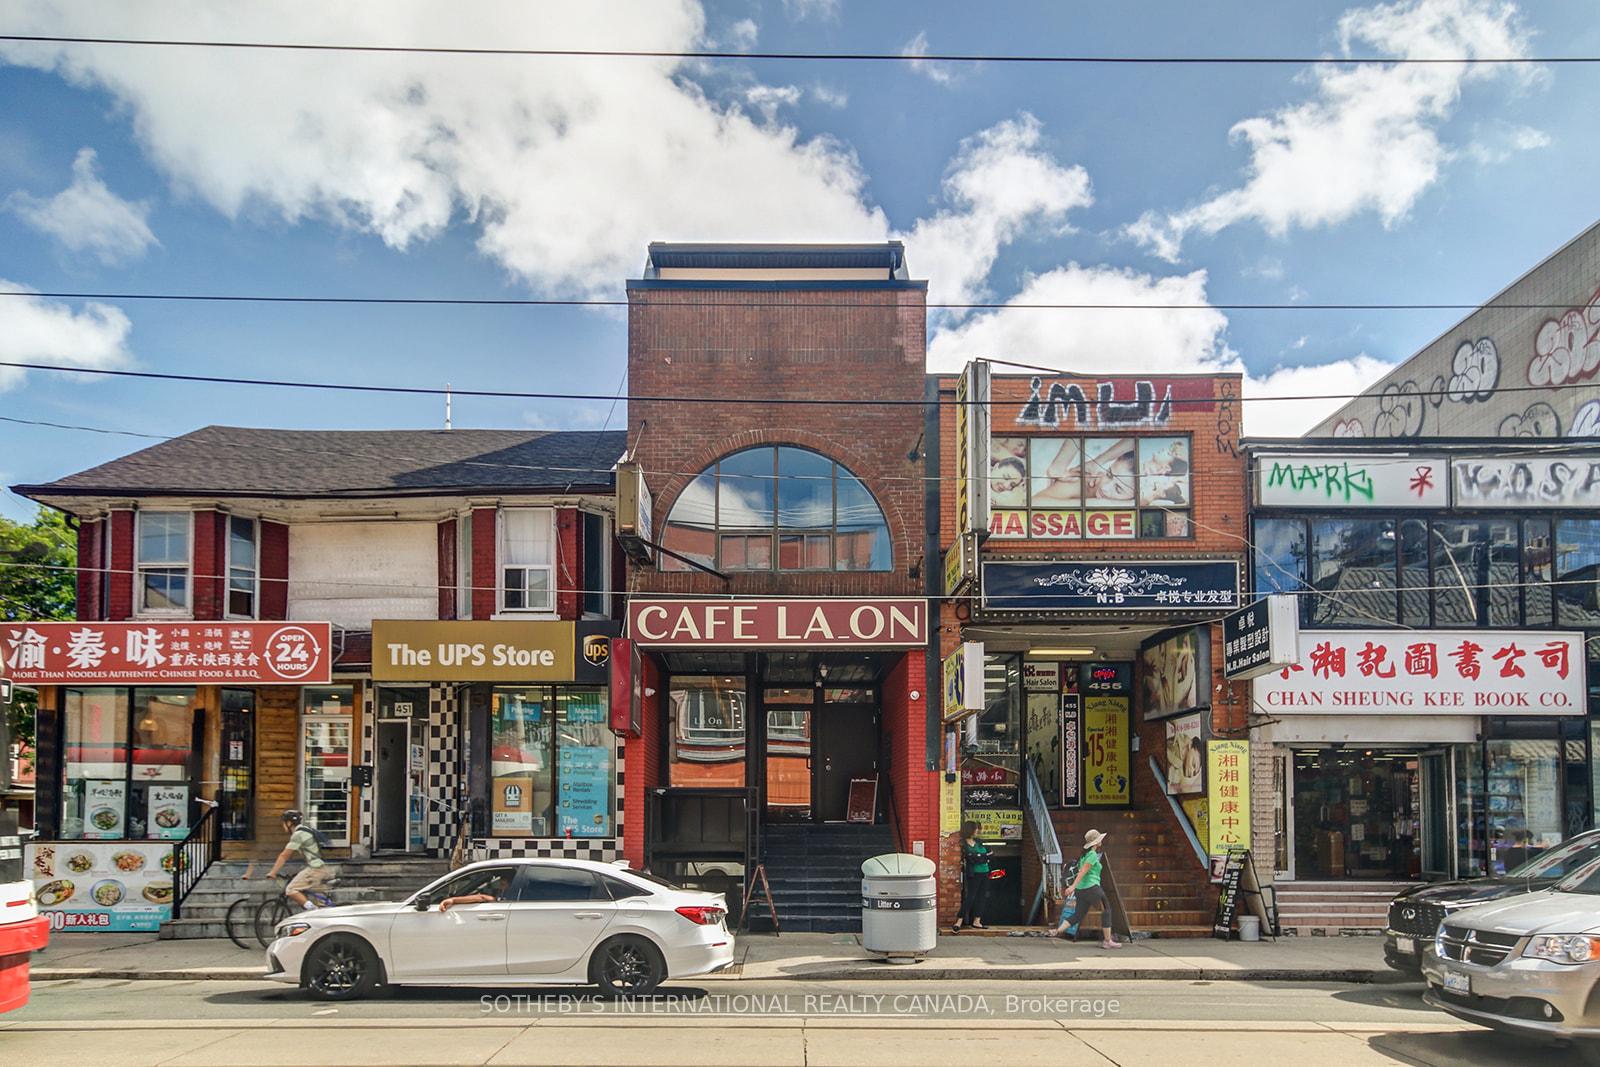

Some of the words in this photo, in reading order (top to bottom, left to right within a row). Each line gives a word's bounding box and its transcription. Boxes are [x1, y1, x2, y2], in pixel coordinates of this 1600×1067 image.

[1096, 593, 1125, 604] N.B
[637, 605, 758, 640] CAFE
[280, 634, 305, 642] OPEN
[275, 642, 309, 662] 24
[387, 643, 432, 666] The
[438, 643, 486, 666] UPS
[493, 643, 555, 666] Store
[585, 640, 609, 662] ups
[1252, 649, 1270, 663] Salon
[277, 663, 307, 671] HOURS
[1280, 640, 1570, 682] 湘記圖書公司
[199, 669, 224, 678] FOOD
[225, 669, 232, 678] &
[1267, 690, 1323, 706] CHAN
[1332, 690, 1414, 706] SHEUNG
[1424, 691, 1465, 706] KEE
[1475, 691, 1530, 706] BOOK
[1540, 691, 1573, 707] CO.
[396, 704, 412, 714] 451
[1218, 754, 1240, 844] 湘湘健康中心
[877, 900, 892, 908] Litter
